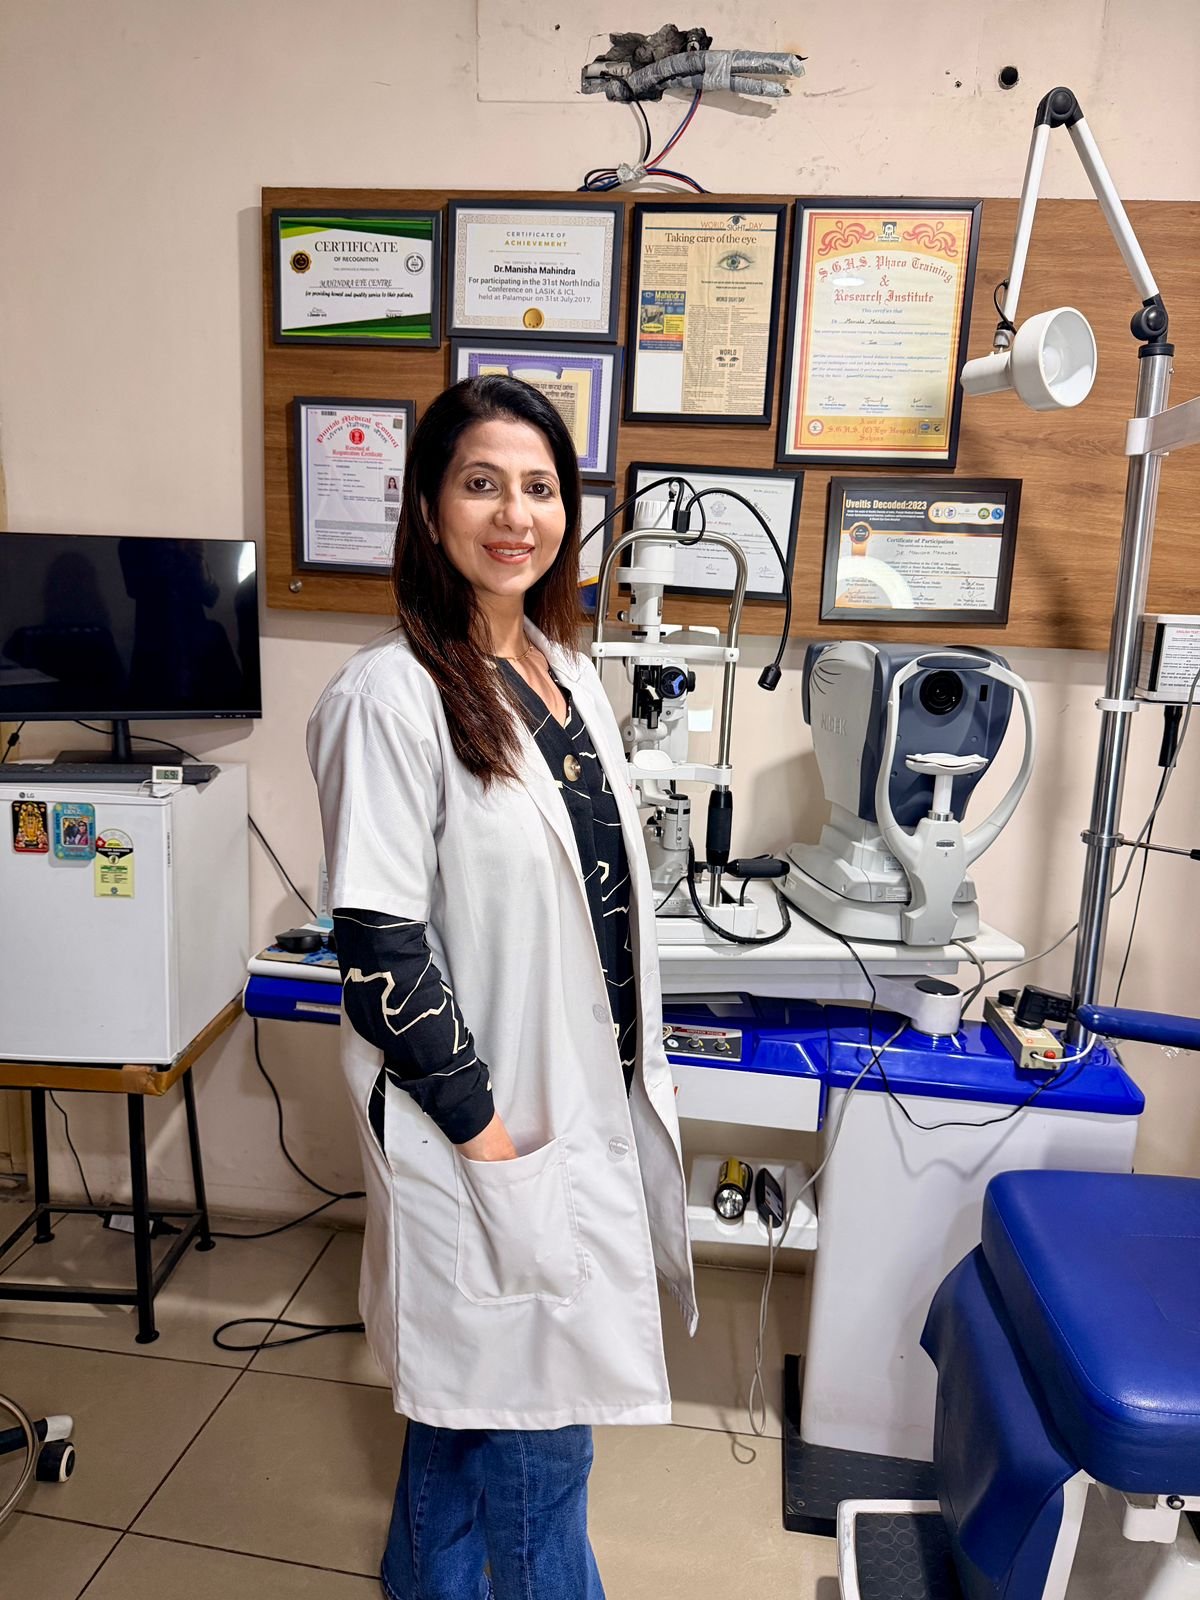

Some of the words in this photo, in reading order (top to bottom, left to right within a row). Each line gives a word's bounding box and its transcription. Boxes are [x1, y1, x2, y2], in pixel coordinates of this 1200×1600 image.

[700, 221, 724, 229] WORLD
[749, 222, 763, 230] DAY
[665, 232, 695, 244] Taking
[696, 235, 715, 243] care
[716, 233, 725, 243] of
[726, 234, 740, 243] the
[741, 236, 757, 245] eye
[314, 241, 398, 252] CERTIFICATE
[493, 265, 538, 274] Dr.Manisha
[539, 266, 576, 275] Mahindra
[876, 256, 907, 270] Phaco
[911, 256, 953, 283] Training
[480, 277, 520, 286] participating
[559, 279, 580, 287] North
[580, 279, 600, 288] India
[880, 274, 889, 287] &
[834, 289, 882, 304] Research
[884, 290, 934, 305] Institute
[846, 499, 871, 508] Uveitis
[873, 500, 927, 510] Decoded:2023
